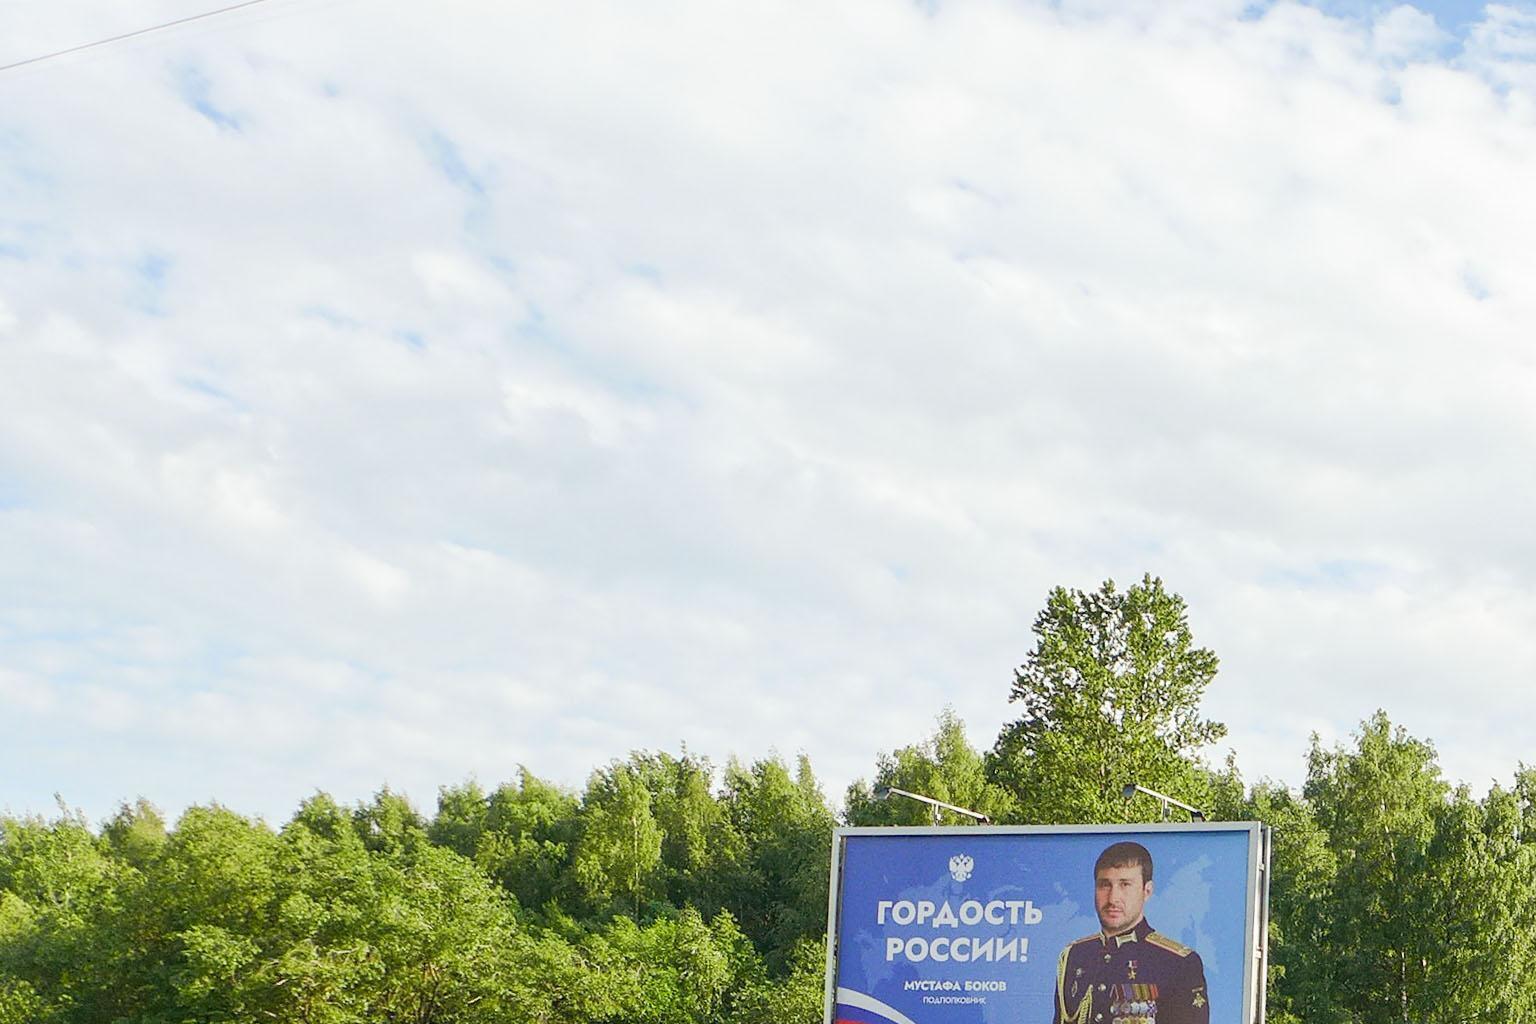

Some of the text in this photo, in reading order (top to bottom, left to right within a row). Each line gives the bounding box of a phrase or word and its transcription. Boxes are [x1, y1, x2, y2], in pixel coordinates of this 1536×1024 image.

[877, 900, 1043, 928] ГОРДОСТЬ
[886, 937, 1029, 962] РОССИИ!
[904, 980, 1007, 991] МУСТАФА БОКОВ
